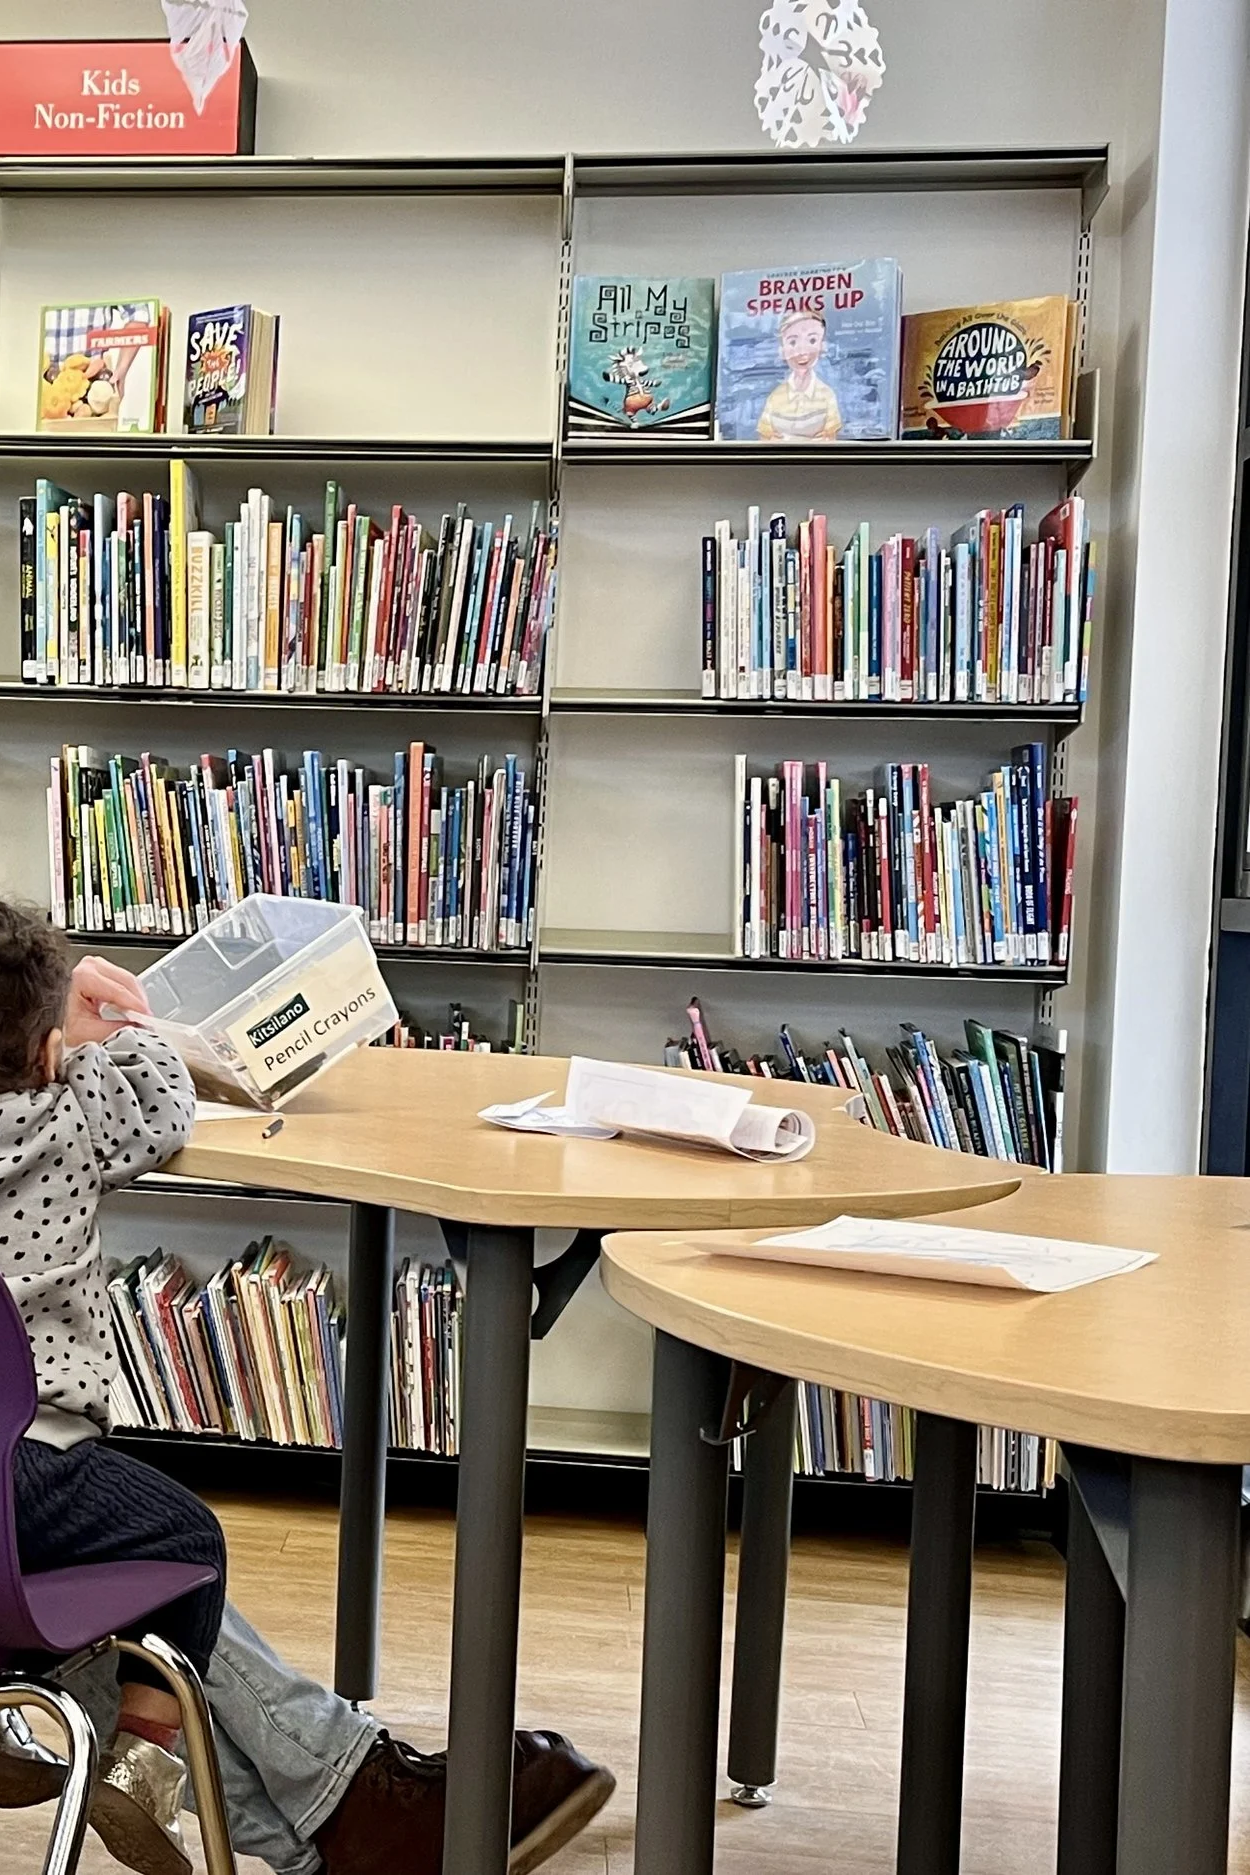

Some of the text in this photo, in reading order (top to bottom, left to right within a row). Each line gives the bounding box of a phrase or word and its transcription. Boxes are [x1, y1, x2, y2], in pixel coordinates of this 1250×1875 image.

[81, 69, 141, 96] Kids
[34, 103, 185, 129] Non-Fiction
[759, 273, 852, 296] BRAYDEN
[597, 284, 687, 324] All My
[747, 290, 864, 317] SPEAKS UP
[190, 322, 244, 361] SAVE
[589, 310, 690, 348] Stripes
[941, 327, 1017, 358] AROUND
[937, 351, 1025, 378] THE WORLD
[936, 380, 946, 392] IN
[947, 385, 955, 396] A
[956, 375, 1020, 398] BATHTUB
[25, 564, 33, 599] ANIMAL
[191, 546, 203, 614] BUZZKILL
[249, 1002, 304, 1048] Kitsilano
[263, 986, 377, 1071] Pencil Crayons
